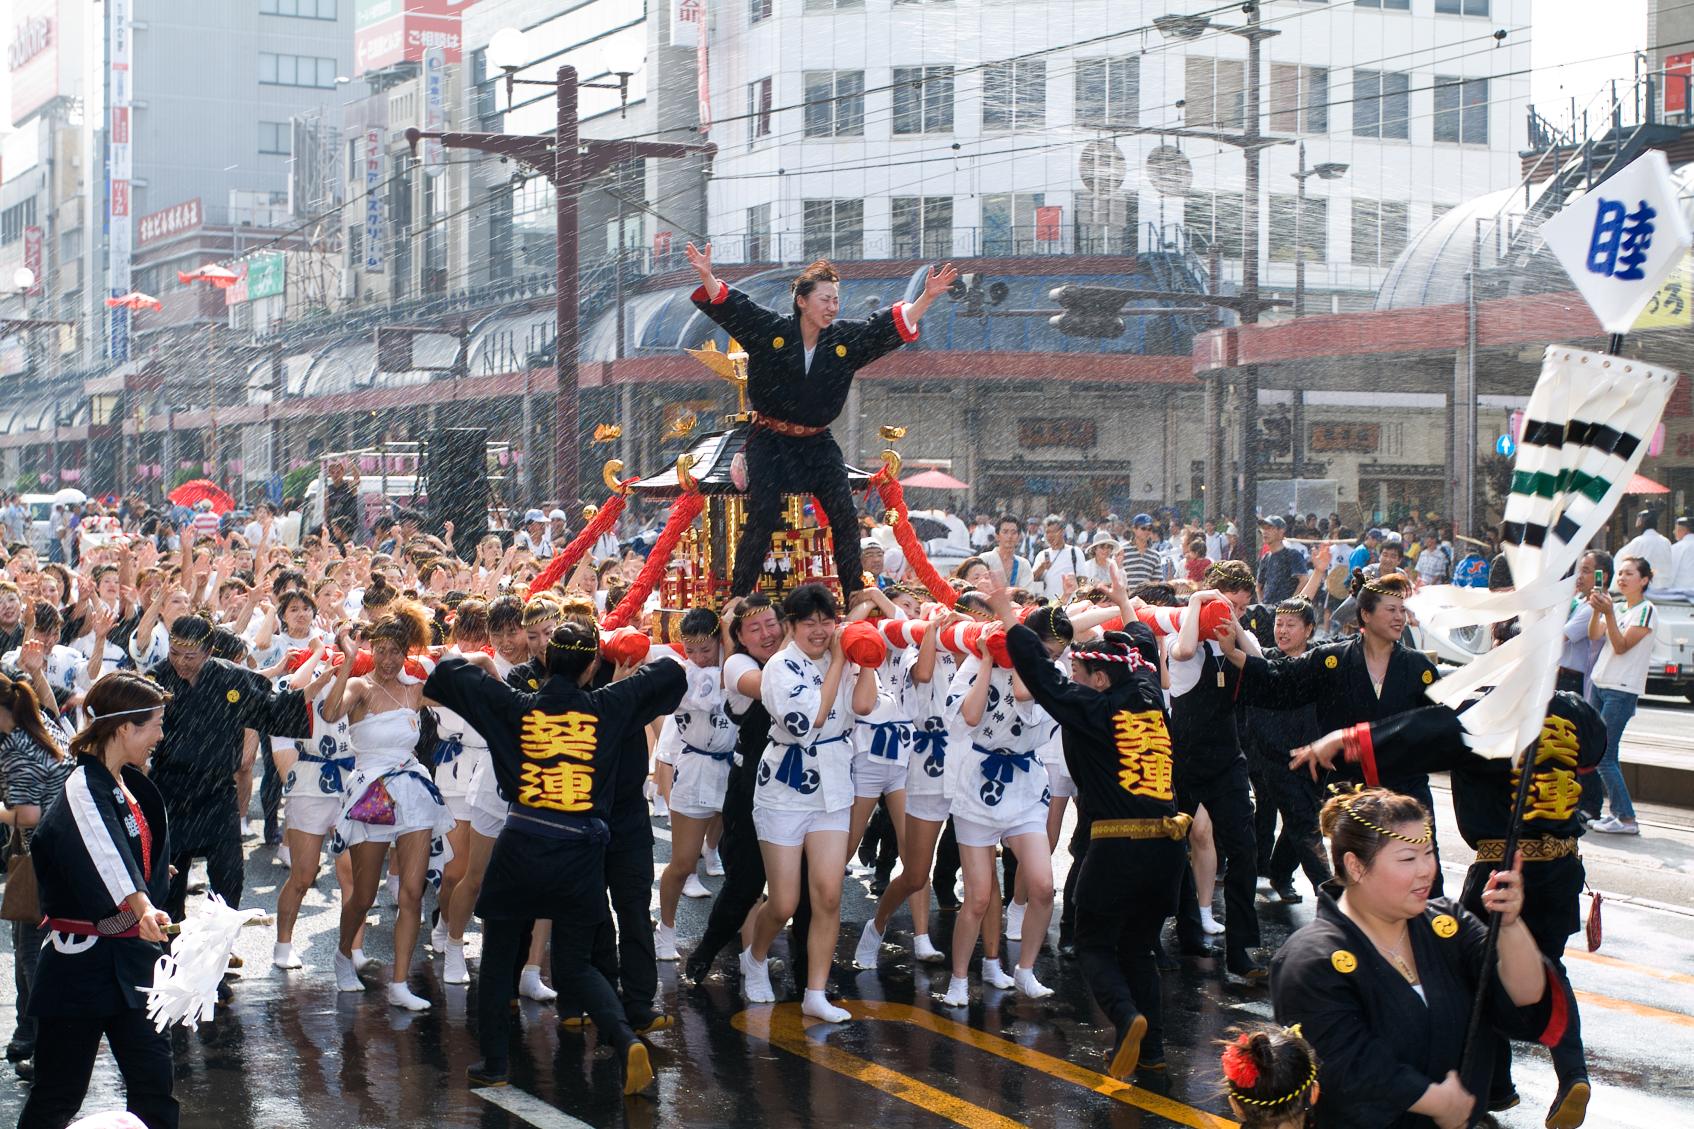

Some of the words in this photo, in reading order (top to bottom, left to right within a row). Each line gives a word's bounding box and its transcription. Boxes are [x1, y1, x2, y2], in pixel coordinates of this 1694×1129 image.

[1586, 197, 1656, 280] 睦
[519, 709, 599, 812] 葵連
[1112, 709, 1174, 801] 葵連
